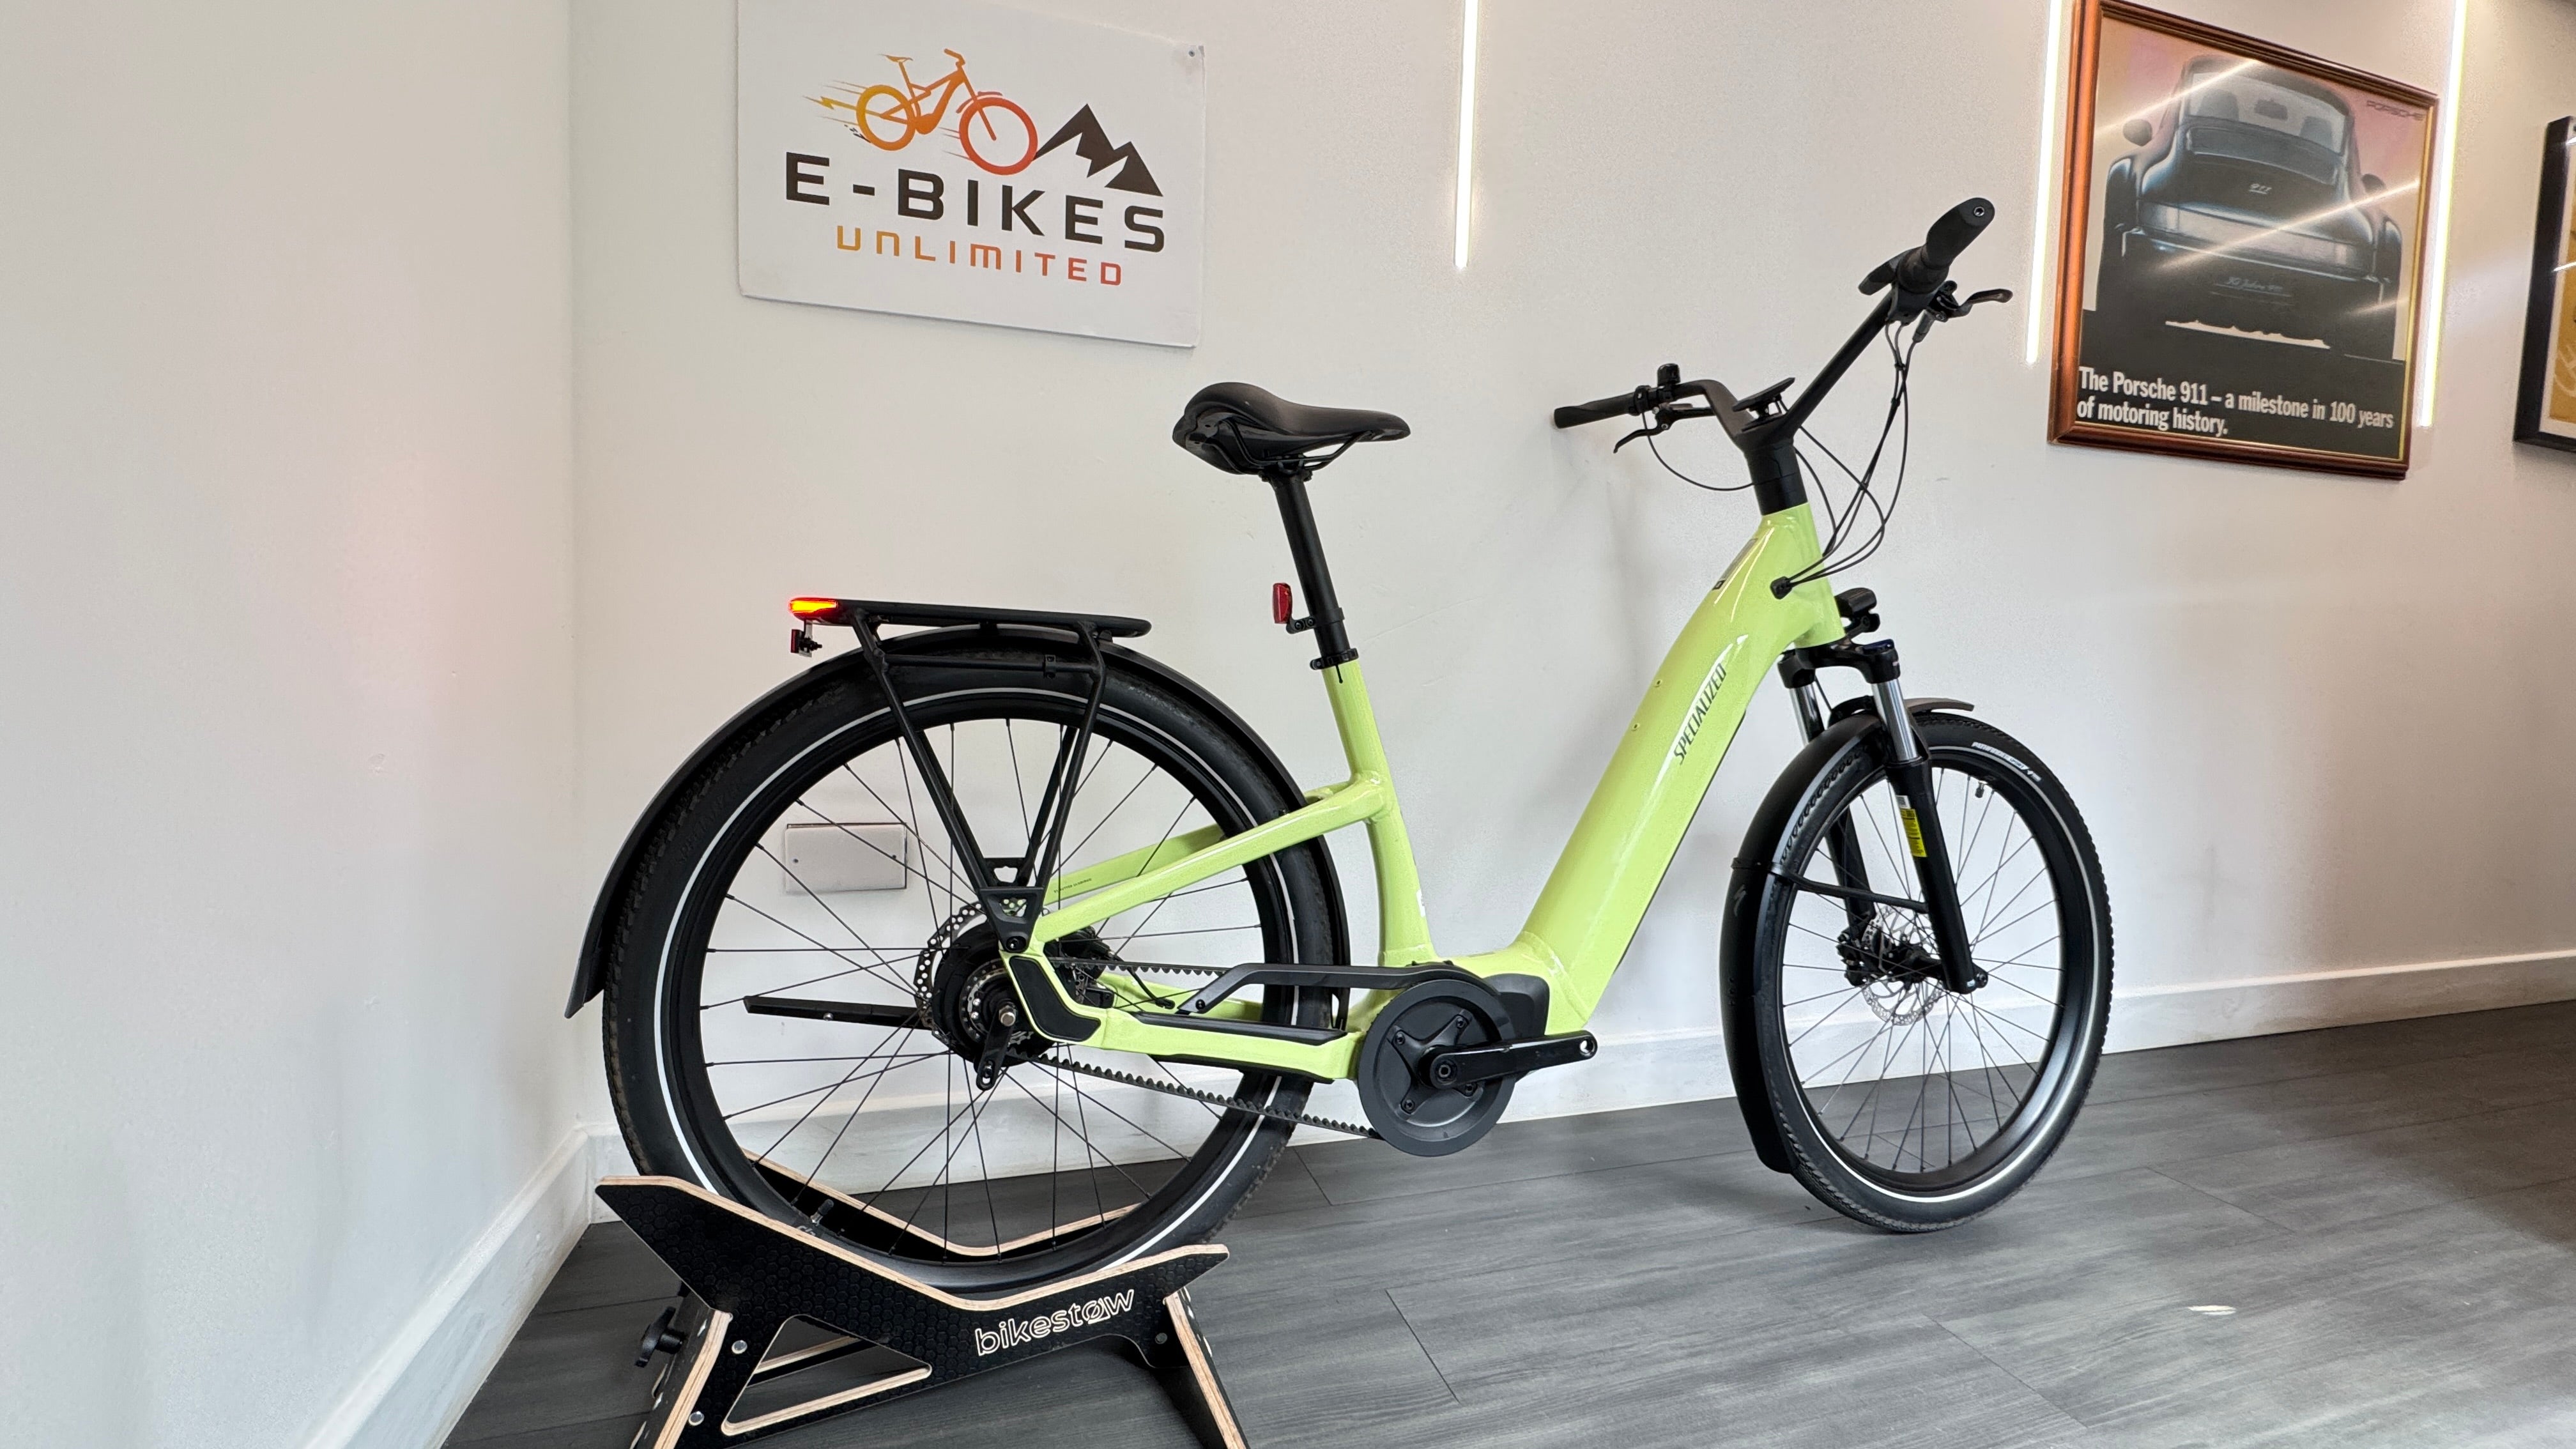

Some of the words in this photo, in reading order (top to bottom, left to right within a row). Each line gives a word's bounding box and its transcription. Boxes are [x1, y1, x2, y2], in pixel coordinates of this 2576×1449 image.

[785, 151, 1165, 253] E-BIKES
[2076, 395, 2096, 418] of
[2097, 401, 2170, 431] motoring
[2172, 406, 2228, 438] history.
[2078, 365, 2109, 392] The
[2112, 371, 2176, 401] Porsche
[2180, 381, 2209, 406] 911
[2225, 392, 2235, 409] a
[2238, 390, 2309, 418] milestone
[2312, 398, 2326, 420] in
[2329, 401, 2357, 424] 100
[2357, 409, 2394, 429] years
[1673, 663, 1727, 766] SPECIALIZED
